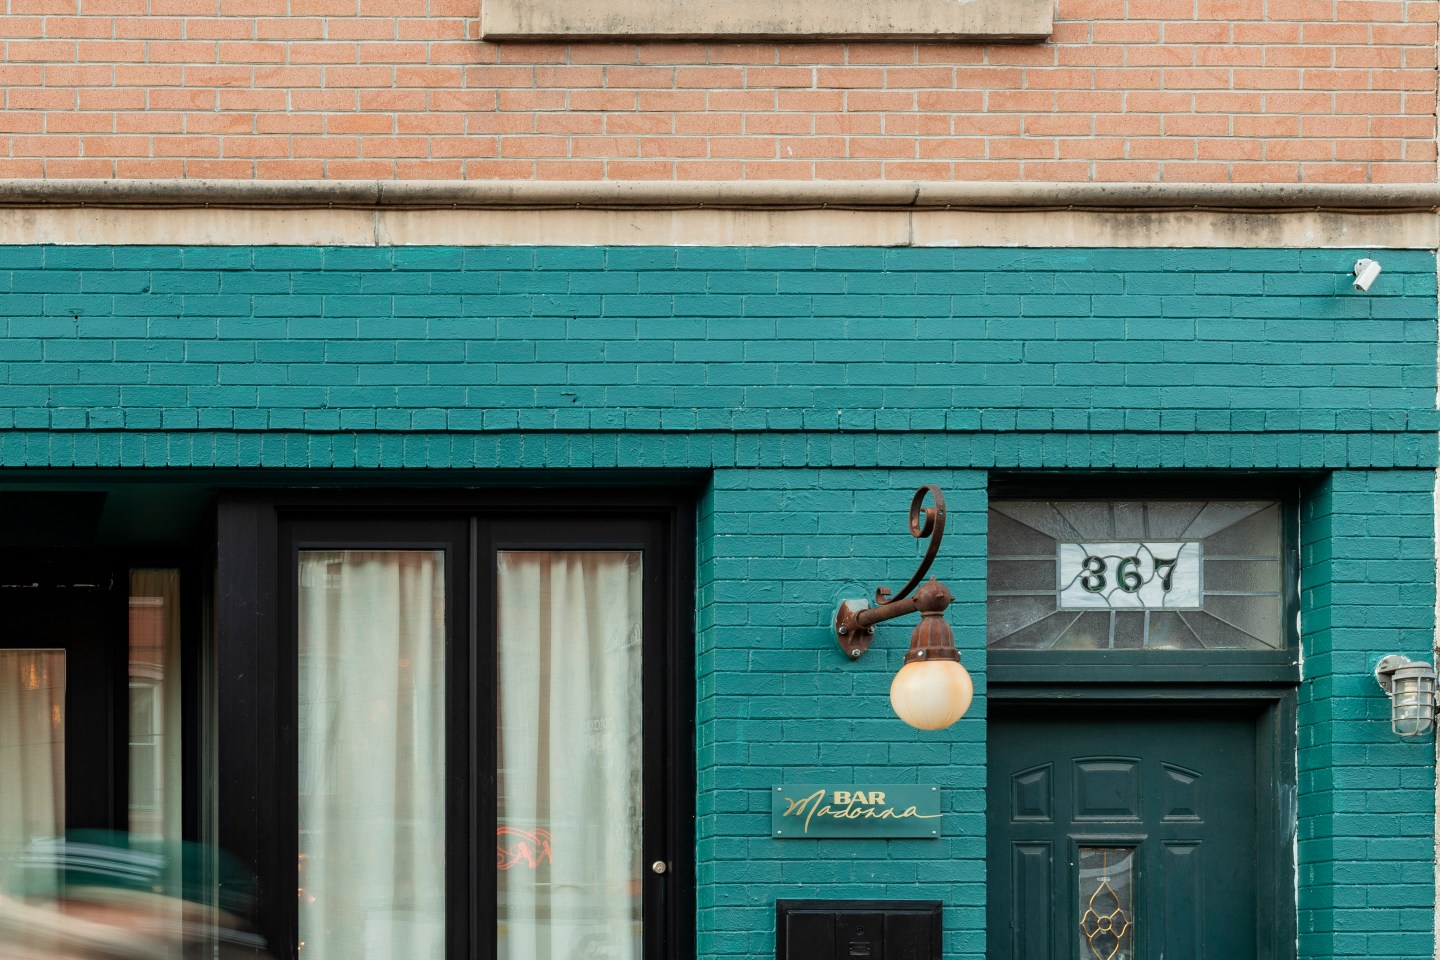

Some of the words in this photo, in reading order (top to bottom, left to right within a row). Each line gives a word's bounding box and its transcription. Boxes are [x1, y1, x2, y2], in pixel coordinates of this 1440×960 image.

[1081, 556, 1177, 593] 367
[783, 789, 944, 833] Madonna
[833, 791, 886, 805] BAR
